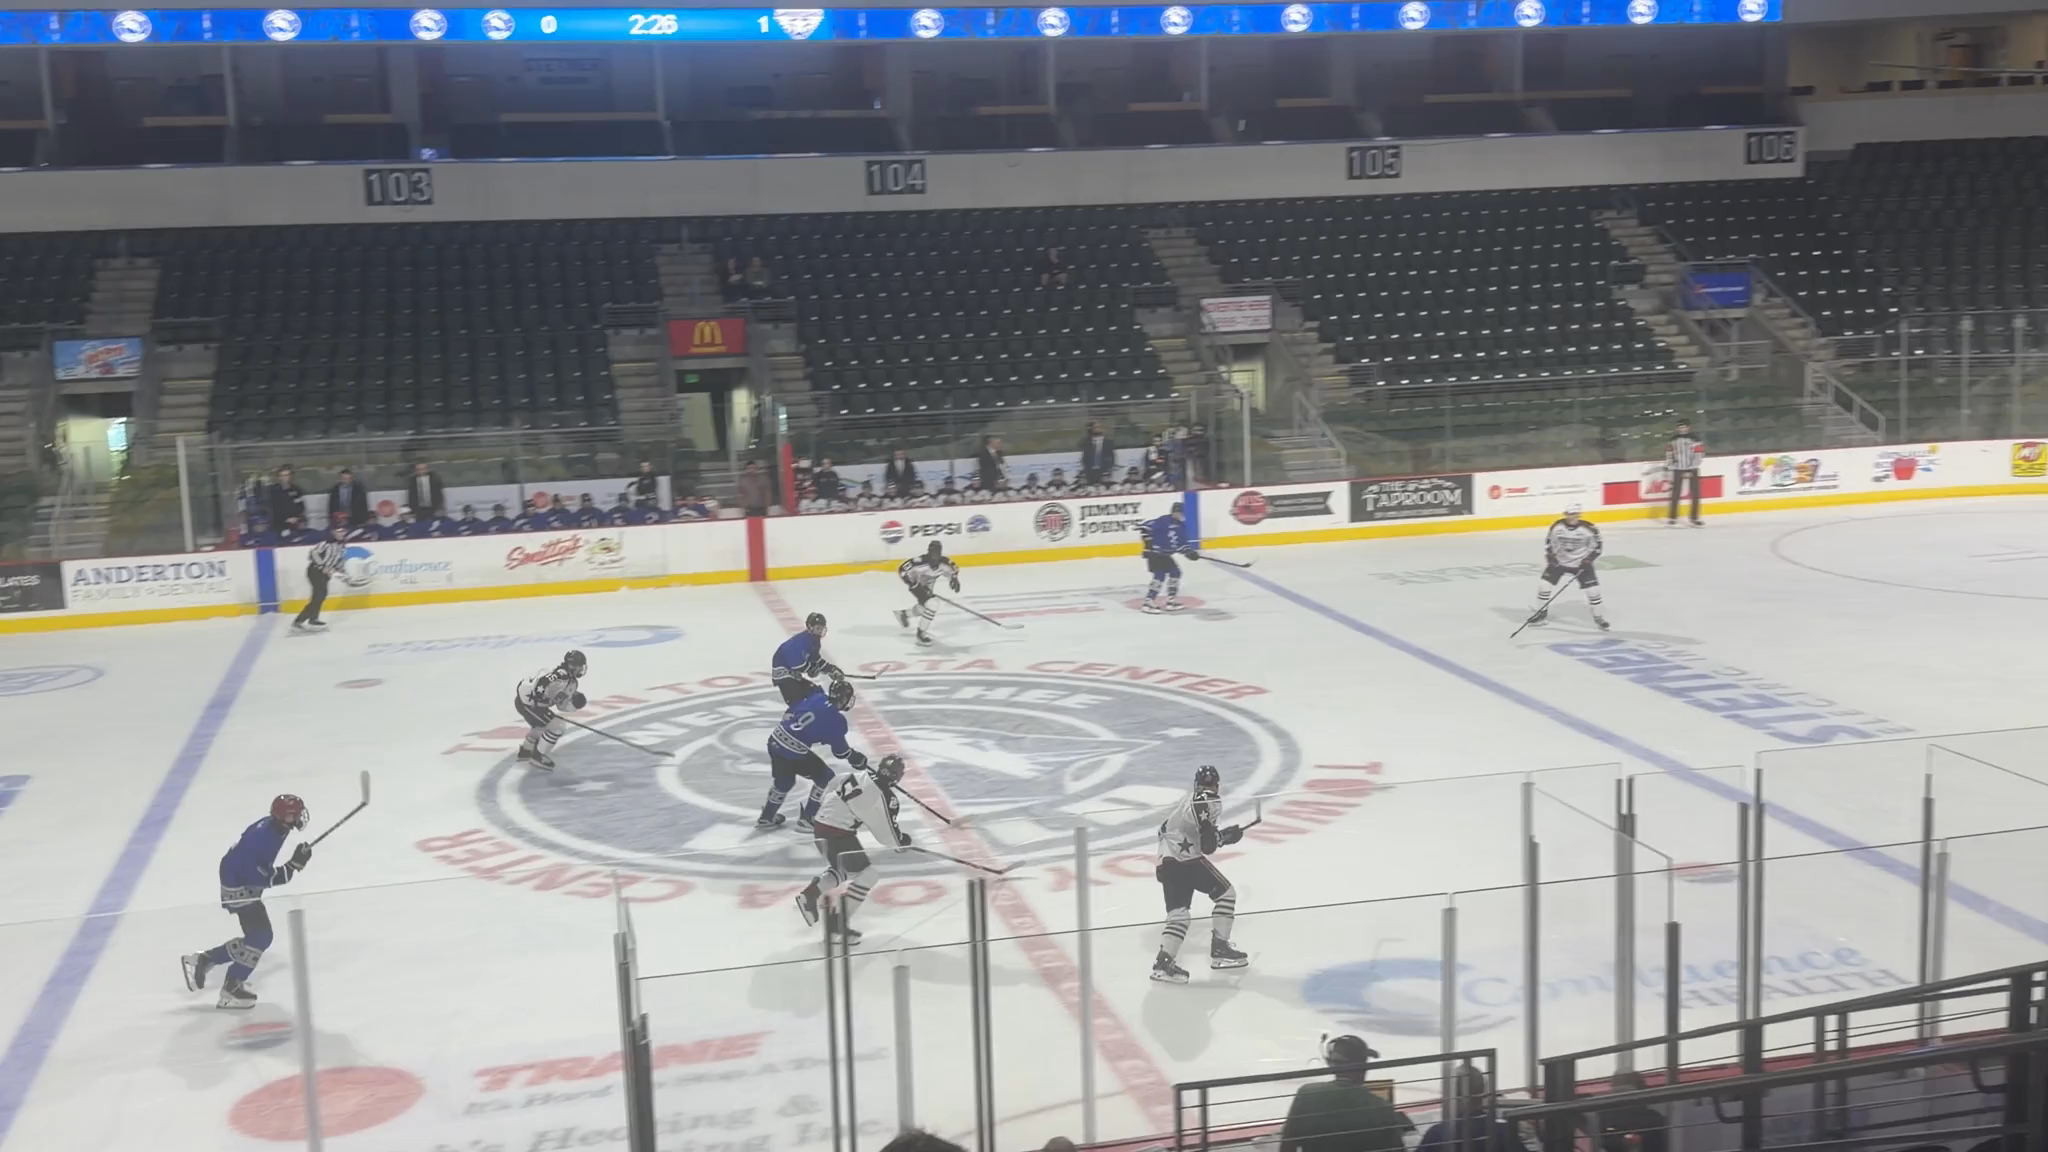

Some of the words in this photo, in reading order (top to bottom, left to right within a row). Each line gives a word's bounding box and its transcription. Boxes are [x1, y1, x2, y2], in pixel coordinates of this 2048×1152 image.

[540, 15, 558, 34] 0
[757, 15, 769, 33] 1
[1350, 147, 1400, 177] 105
[366, 171, 432, 203] 103
[868, 161, 925, 193] 104
[1079, 502, 1142, 521] JIMMY
[1361, 487, 1463, 512] TAPROOM
[910, 522, 962, 538] PEPSI
[71, 560, 228, 587] ANDERTON
[1027, 660, 1272, 699] CENTER
[474, 1030, 776, 1092] TRANE
